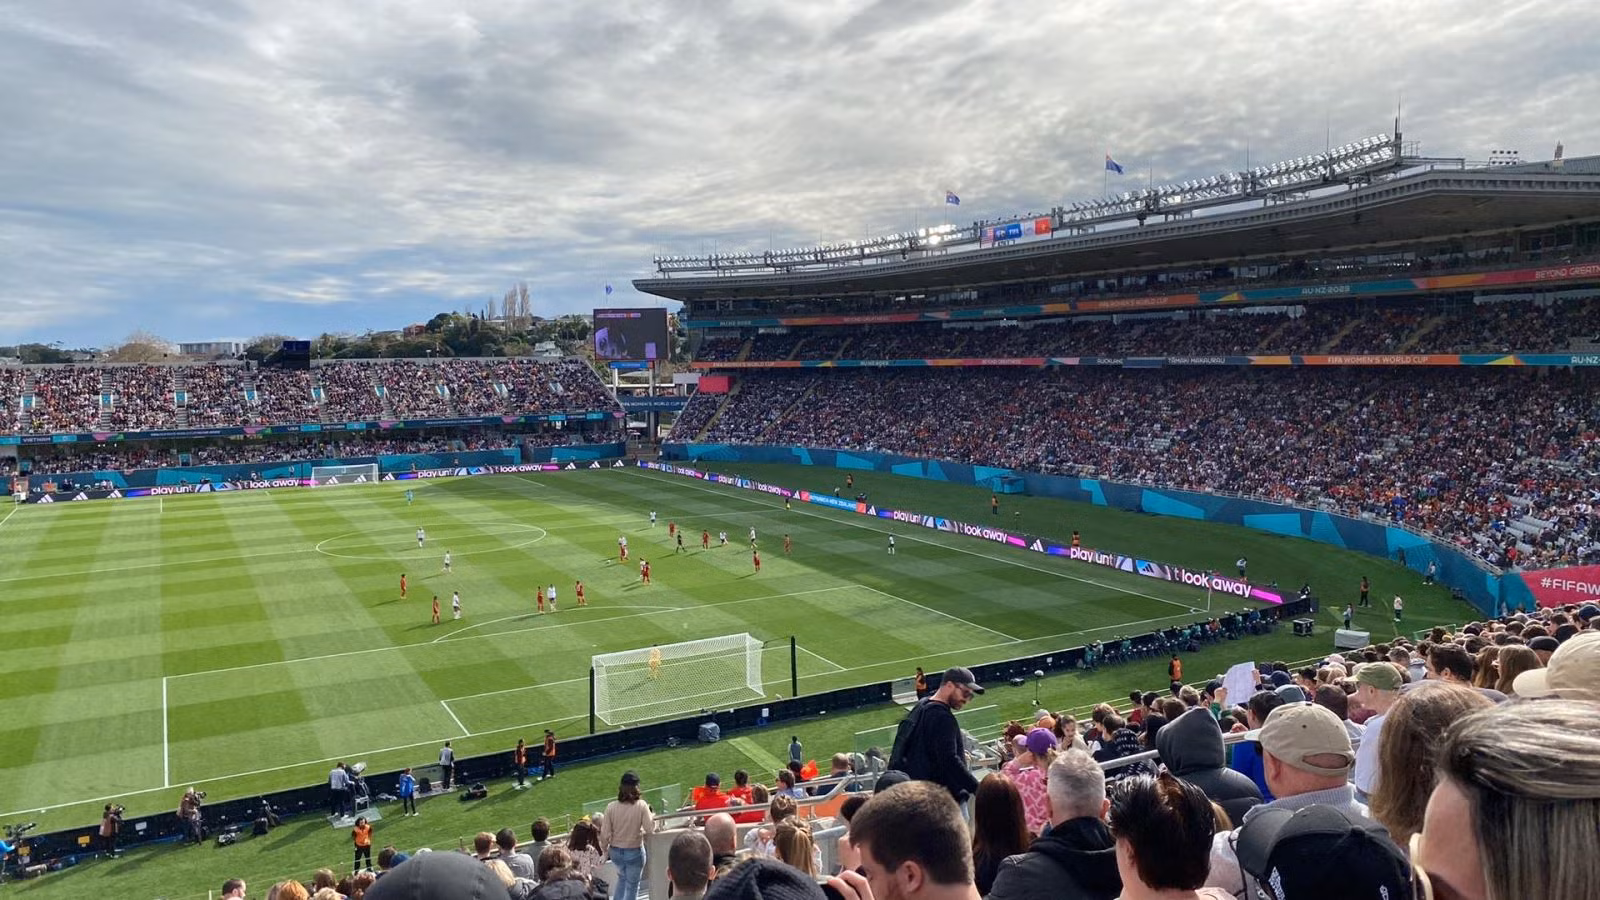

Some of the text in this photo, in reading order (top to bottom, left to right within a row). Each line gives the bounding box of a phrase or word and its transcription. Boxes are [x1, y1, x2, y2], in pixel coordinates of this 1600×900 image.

[1535, 268, 1568, 279] BEYOND
[1327, 356, 1429, 364] FIFA WOMEN'S WORLD CUP
[418, 470, 437, 479] play
[500, 465, 518, 473] look
[250, 480, 270, 489] look
[272, 479, 299, 487] away
[150, 486, 174, 496] play
[893, 509, 908, 522] play
[964, 522, 982, 537] look
[983, 529, 1008, 544] away
[1070, 546, 1093, 563] play
[1182, 569, 1210, 588] look
[1212, 577, 1251, 598] away
[1540, 577, 1600, 595] #FIFAW
